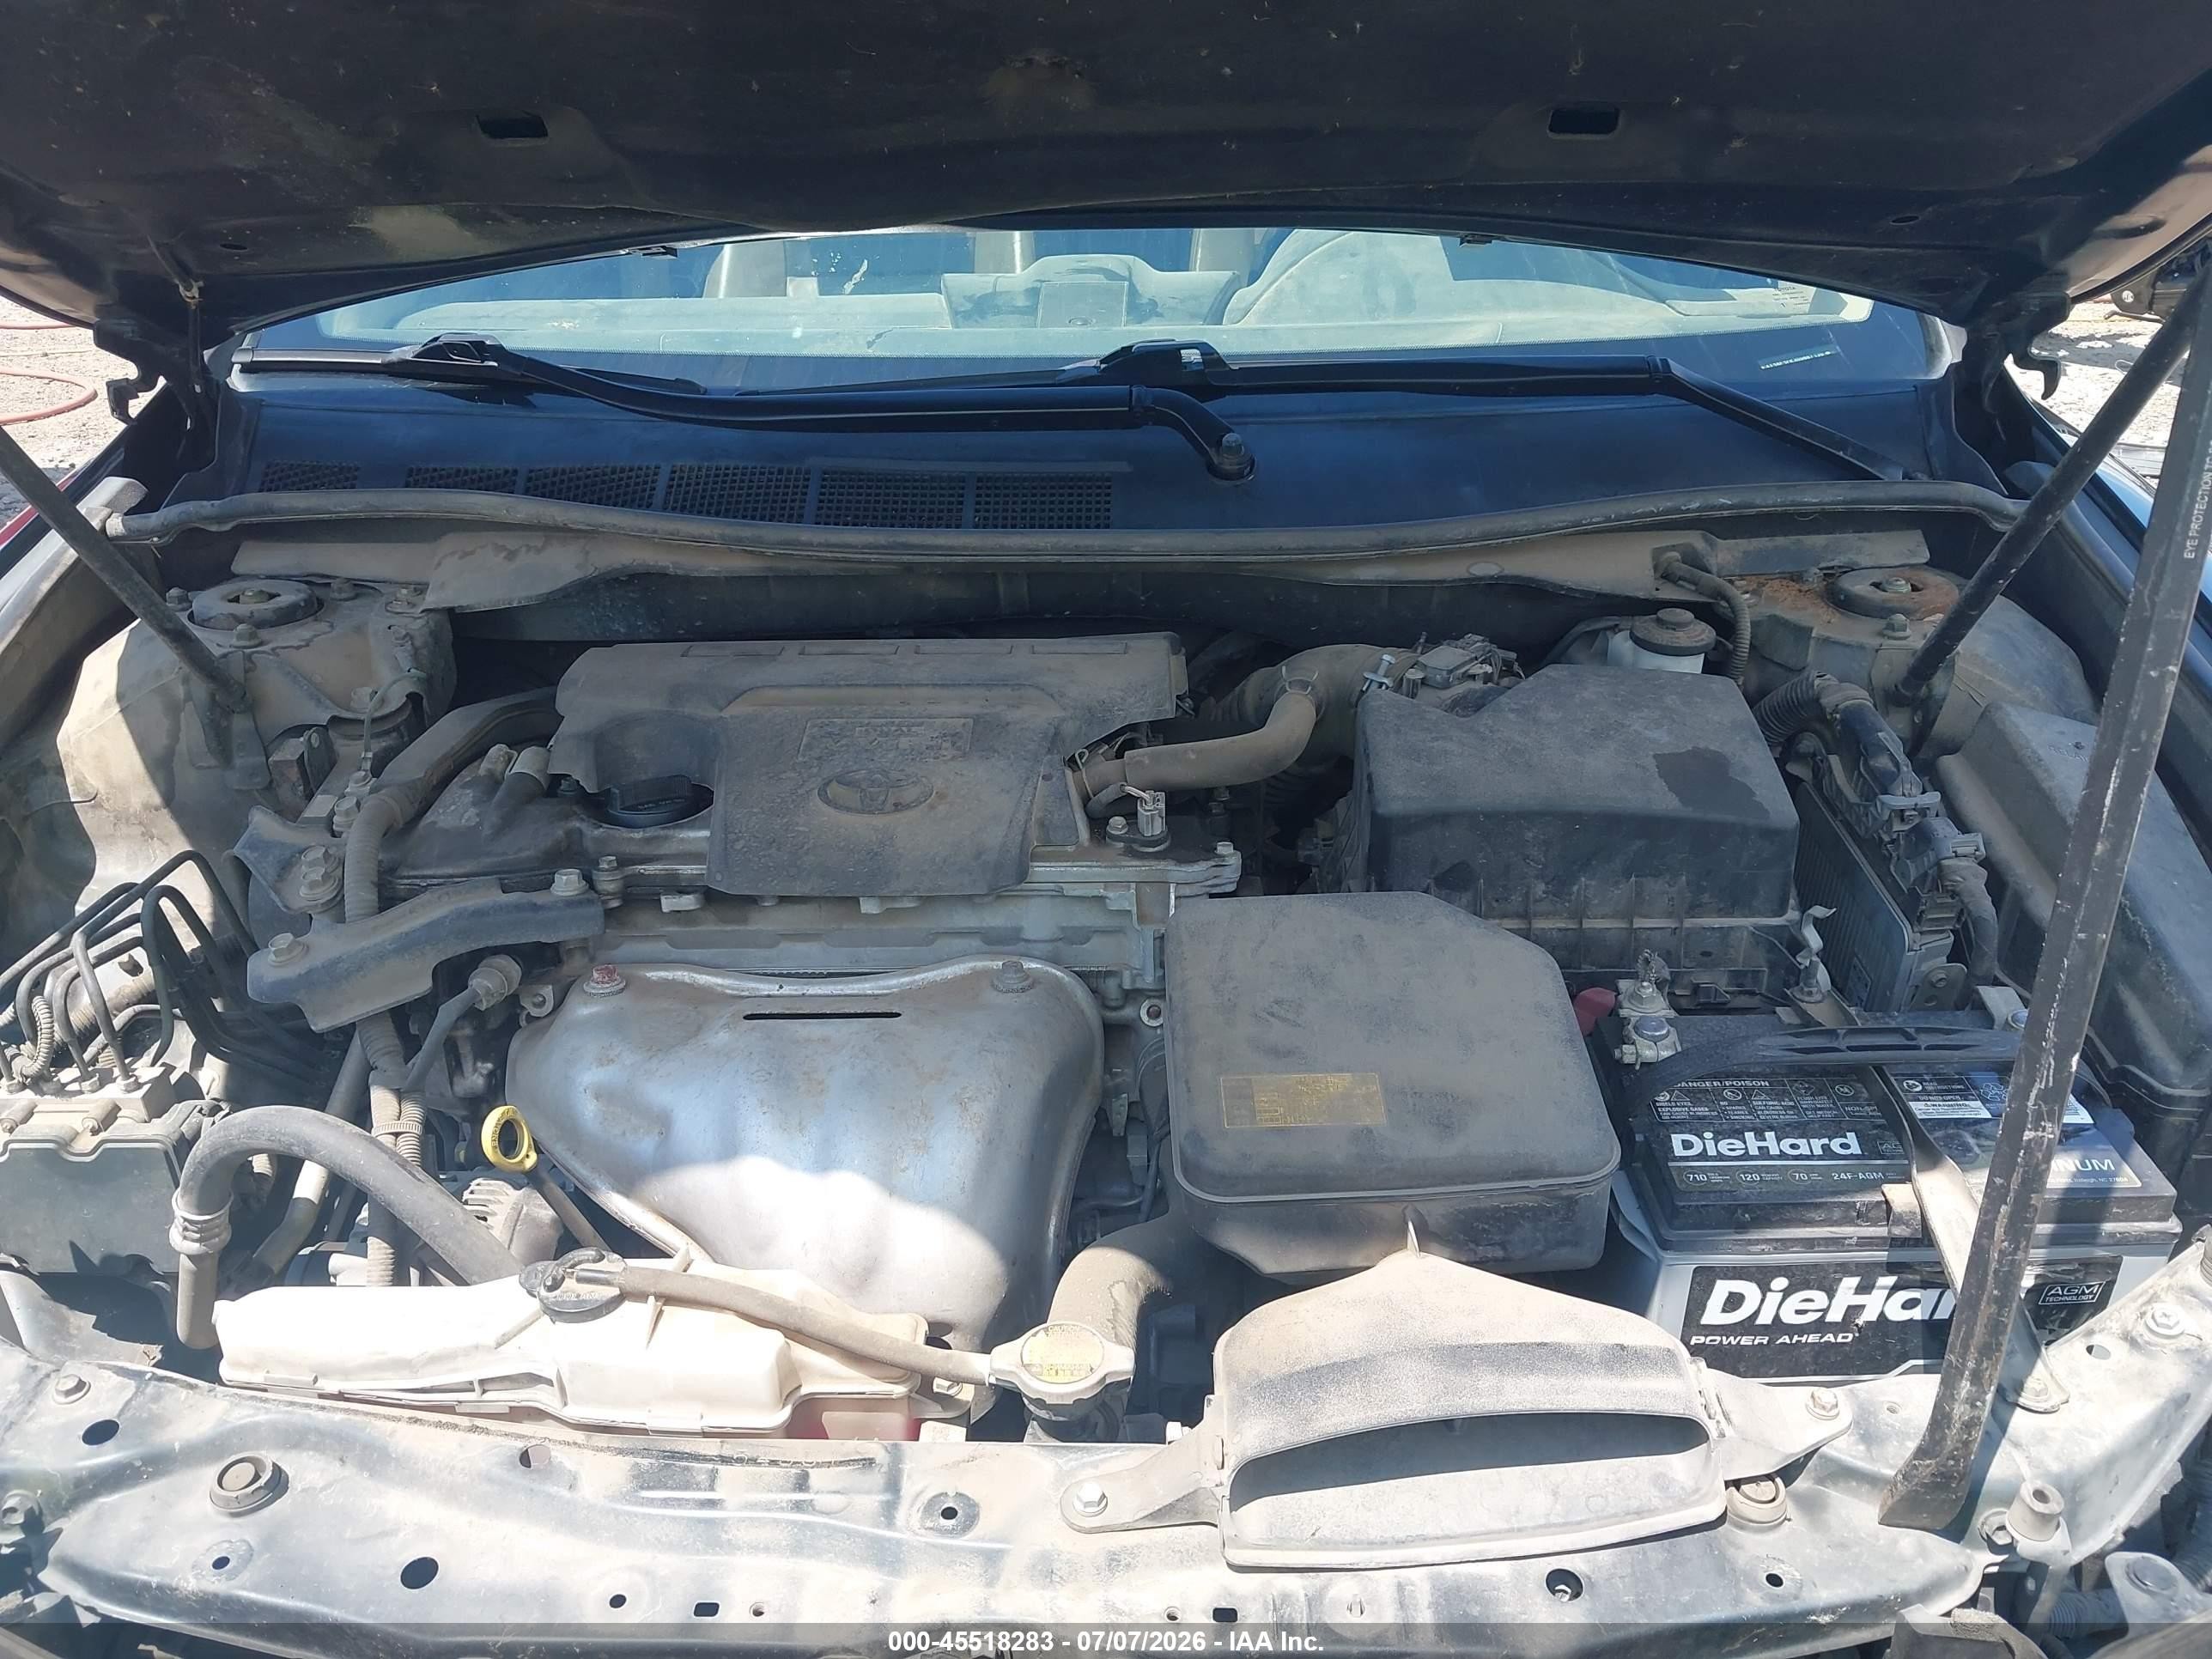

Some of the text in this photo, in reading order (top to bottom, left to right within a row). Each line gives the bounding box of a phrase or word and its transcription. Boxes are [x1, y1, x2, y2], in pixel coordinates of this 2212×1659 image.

[2188, 471, 2212, 537] PROTECTION
[2184, 538, 2199, 559] EYE
[1671, 1132, 1862, 1156] DieHard
[1700, 1276, 1956, 1325] DieHar
[2047, 1284, 2100, 1296] AGM
[1690, 1333, 1855, 1346] POWER AHEAD
